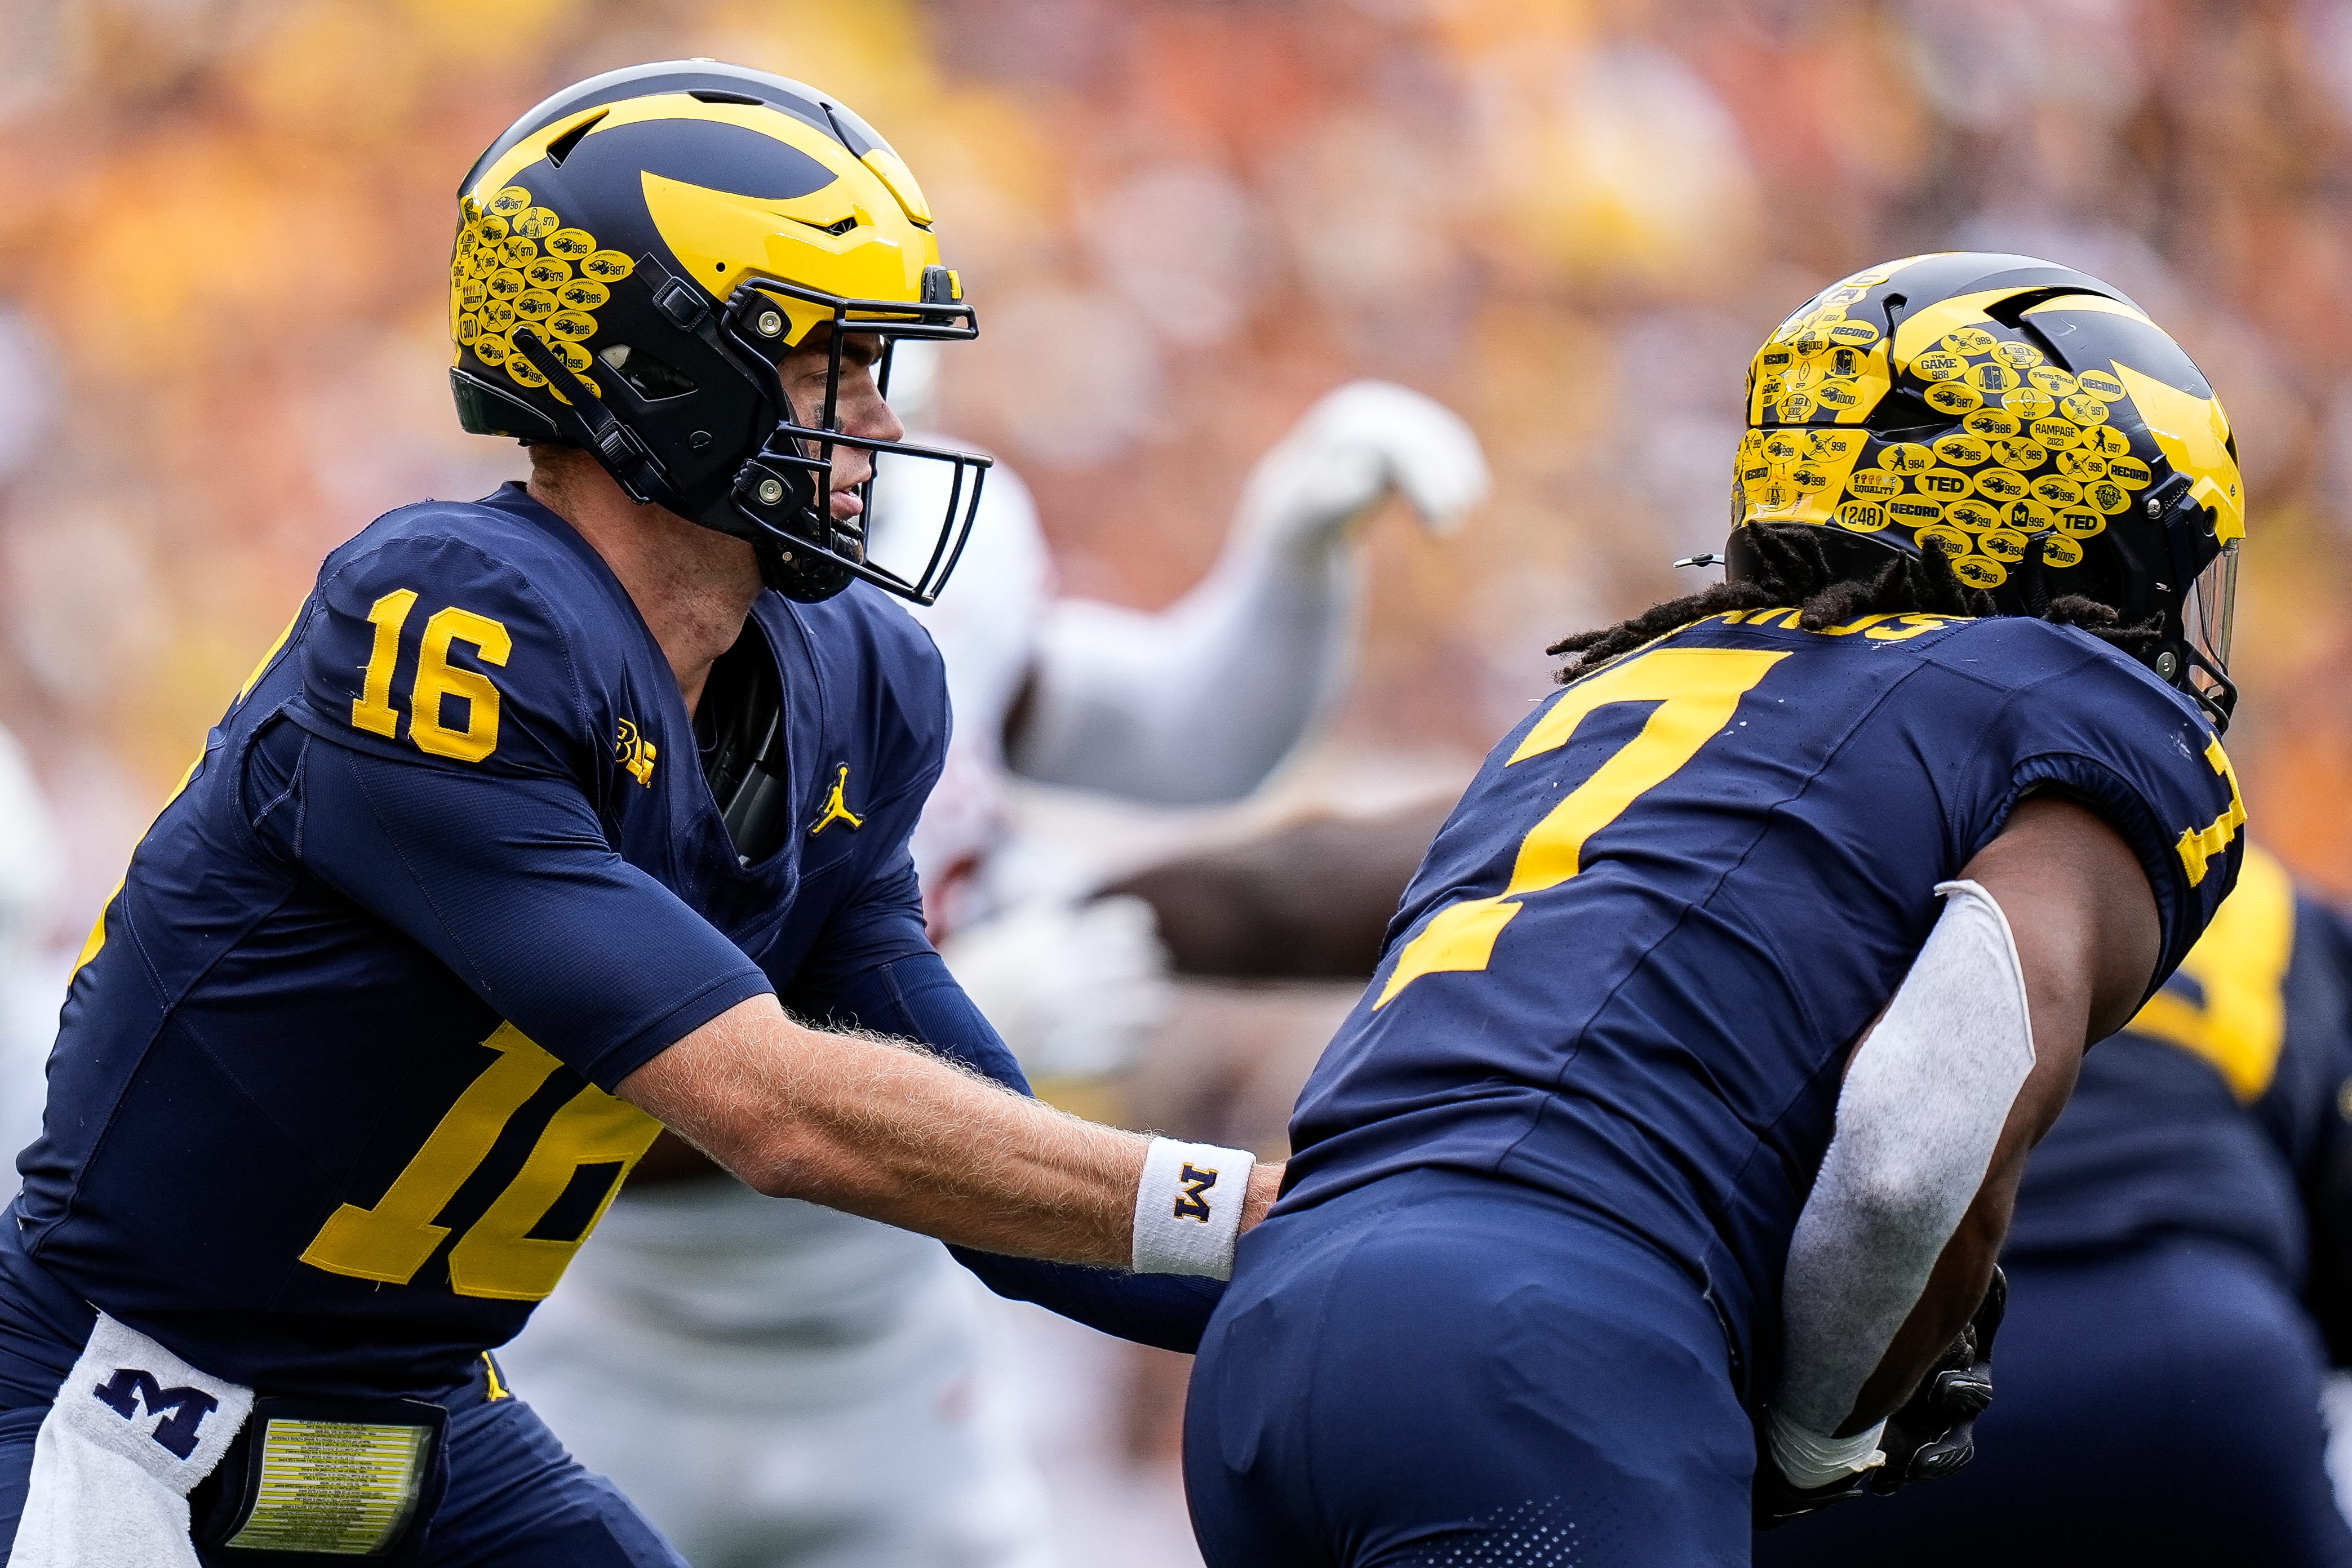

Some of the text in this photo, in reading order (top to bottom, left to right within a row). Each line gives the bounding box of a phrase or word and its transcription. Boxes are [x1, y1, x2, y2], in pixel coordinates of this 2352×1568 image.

[510, 200, 522, 210] 967
[543, 216, 554, 226] 971
[492, 229, 503, 240] 966
[521, 247, 533, 256] 970
[573, 244, 587, 254] 983
[485, 257, 495, 267] 965
[610, 266, 625, 276] 987
[549, 272, 563, 281] 979
[507, 283, 518, 293] 969
[585, 294, 601, 303] 986
[538, 303, 551, 313] 978
[500, 310, 512, 320] 968
[575, 325, 589, 334] 985
[1831, 326, 1875, 340] RECORD
[1808, 340, 1823, 350] 1003
[1976, 337, 1991, 345] 988
[492, 349, 504, 360] 994
[1764, 353, 1790, 366] RECORD
[568, 359, 583, 368] 995
[1921, 359, 1958, 370] GAME
[529, 371, 543, 384] 996
[1932, 370, 1949, 380] 988
[2033, 371, 2075, 385] Fiesta Bowl
[1762, 382, 1781, 394] GAME
[2082, 377, 2122, 395] RECORD
[1836, 394, 1856, 405] 1000
[1956, 398, 1973, 408] 987
[2091, 407, 2105, 416] 997
[1994, 424, 2012, 434] 986
[2035, 423, 2076, 438] RAMPAGE
[1831, 442, 1847, 451] 998
[2047, 437, 2064, 446] 2023
[2107, 442, 2121, 454] 997
[1964, 451, 1982, 461] 985
[2026, 450, 2043, 460] 985
[1908, 459, 1925, 469] 984
[2088, 462, 2102, 472] 996
[2111, 464, 2149, 482] RECORD
[1810, 476, 1826, 486] 998
[1924, 476, 1965, 494] TED
[1854, 485, 1894, 495] EQUALITY
[2004, 485, 2021, 495] 992
[2059, 491, 2075, 502] 996
[1841, 505, 1884, 526] (248)
[1890, 503, 1940, 518] RECORD
[1977, 517, 1991, 528] 991
[2029, 517, 2045, 527] 995
[2063, 513, 2098, 531] TED
[1946, 543, 1963, 554] 990
[2008, 546, 2025, 557] 994
[2056, 550, 2076, 563] 1005
[1981, 572, 1998, 584] 993
[352, 588, 512, 763] 16
[1372, 647, 1794, 1011] 7
[299, 1019, 664, 1302] 16
[1173, 1162, 1219, 1223] M
[92, 1369, 219, 1461] M
